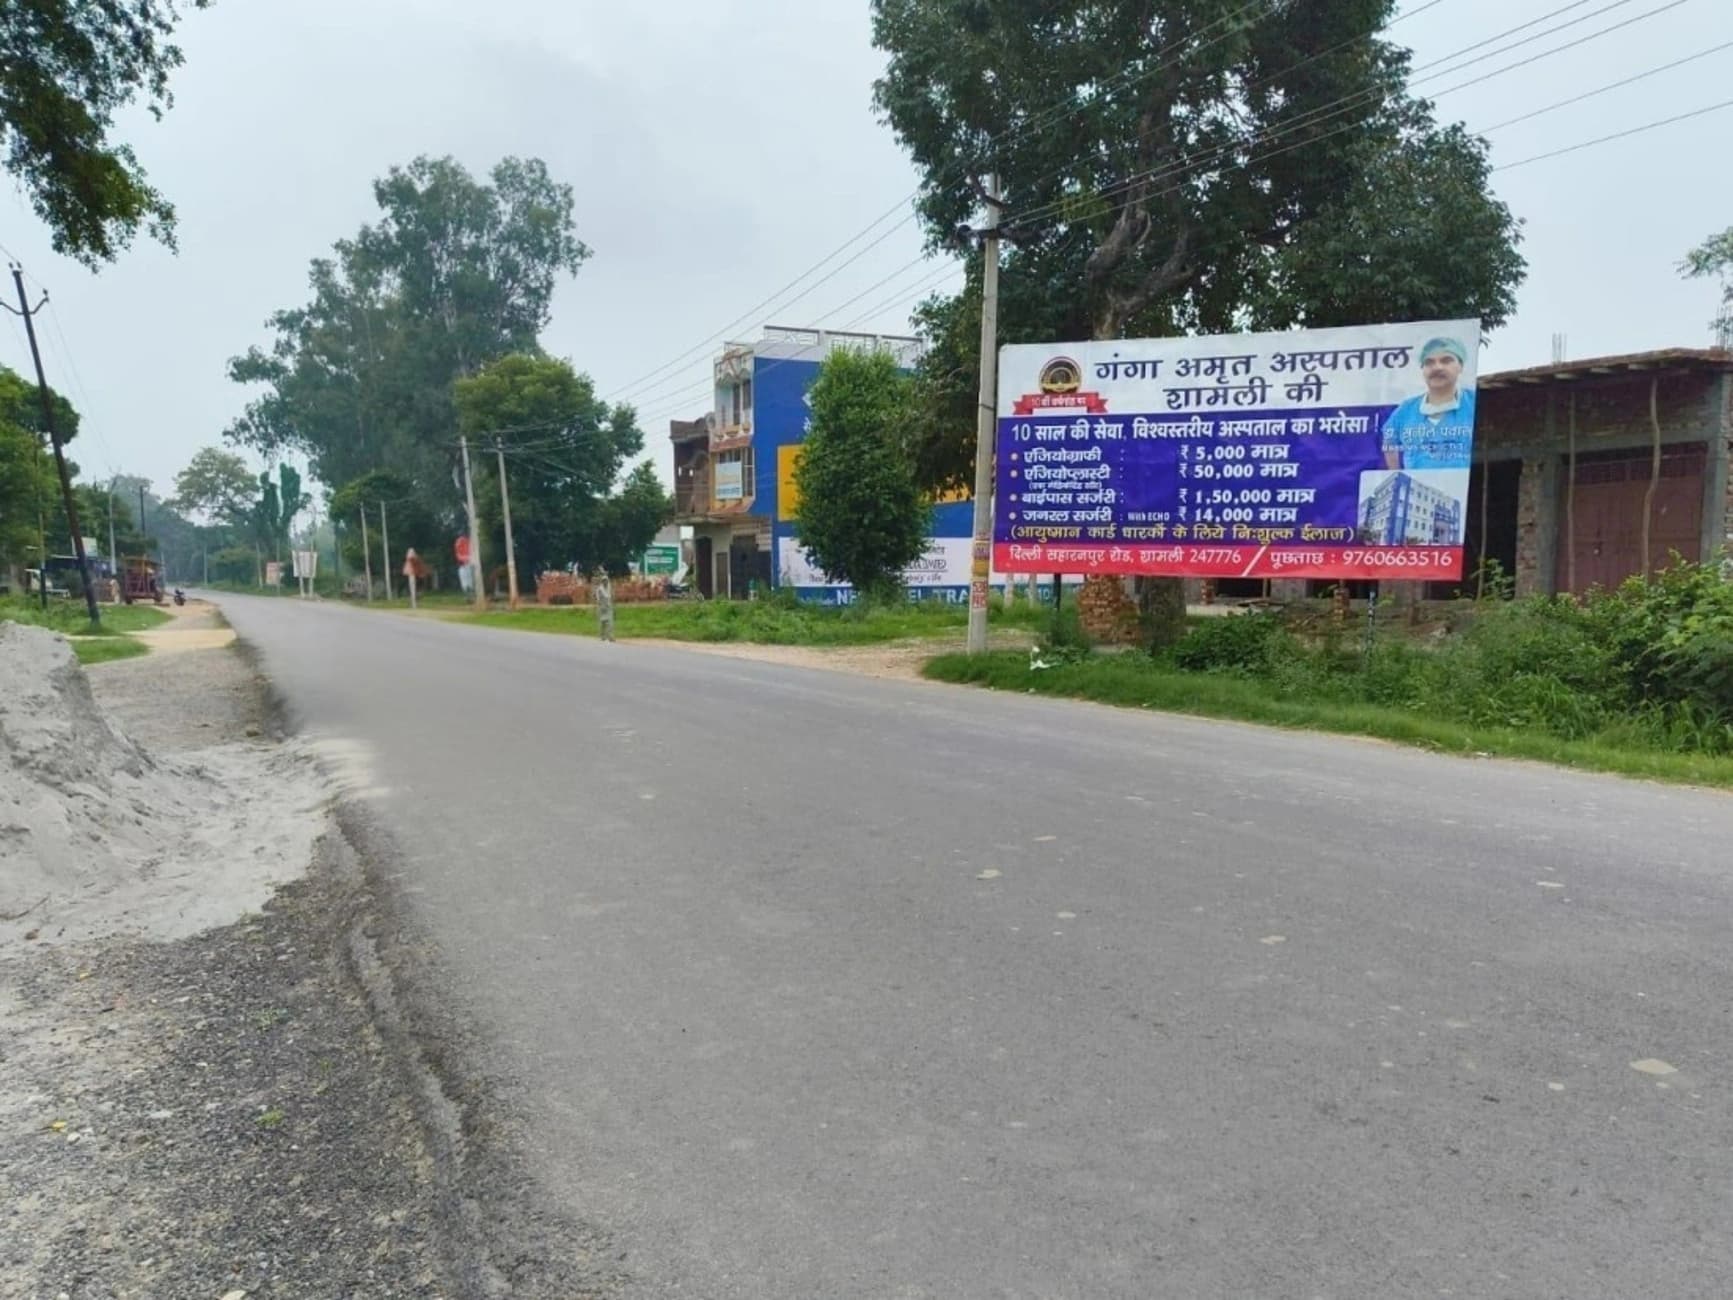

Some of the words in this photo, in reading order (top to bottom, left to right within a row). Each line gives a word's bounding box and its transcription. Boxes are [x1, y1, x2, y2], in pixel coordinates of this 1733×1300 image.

[1094, 353, 1163, 380] गंगा
[1175, 355, 1257, 385] अमृत
[1270, 346, 1413, 373] अस्पताल
[1163, 376, 1273, 410] शामली
[1284, 373, 1328, 403] की
[1011, 424, 1031, 441] 10
[1035, 424, 1066, 441] साल
[1070, 418, 1090, 441] की
[1132, 416, 1215, 439] विश्वस्तरीय
[1219, 417, 1287, 438] अस्पताल
[1291, 417, 1314, 435] का
[1319, 411, 1369, 433] भरोसा
[1195, 446, 1246, 461] 5,000
[1251, 444, 1290, 459] मात्र
[1194, 464, 1254, 479] 50,000
[1259, 463, 1299, 478] मात्र
[1022, 489, 1073, 505] बाईपास
[1076, 488, 1116, 504] सर्जरी
[1195, 489, 1272, 504] 1,50,000
[1276, 488, 1316, 504] मात्र
[1022, 509, 1069, 522] जनरल
[1073, 506, 1112, 522] सर्जरी
[1194, 507, 1253, 523] 14,000
[1259, 507, 1298, 522] मात्र
[1011, 525, 1082, 543] (आयुष्मान
[1088, 523, 1117, 539] कार्ड
[1172, 523, 1188, 539] के
[1193, 523, 1227, 540] लिये
[1009, 545, 1041, 561] दिल्ली
[1046, 549, 1106, 566] सहारनपुर
[1140, 546, 1184, 563] शामली
[1189, 549, 1241, 564] 247776
[1270, 552, 1324, 568] पूछताछ
[1342, 551, 1452, 566] 9760663516
